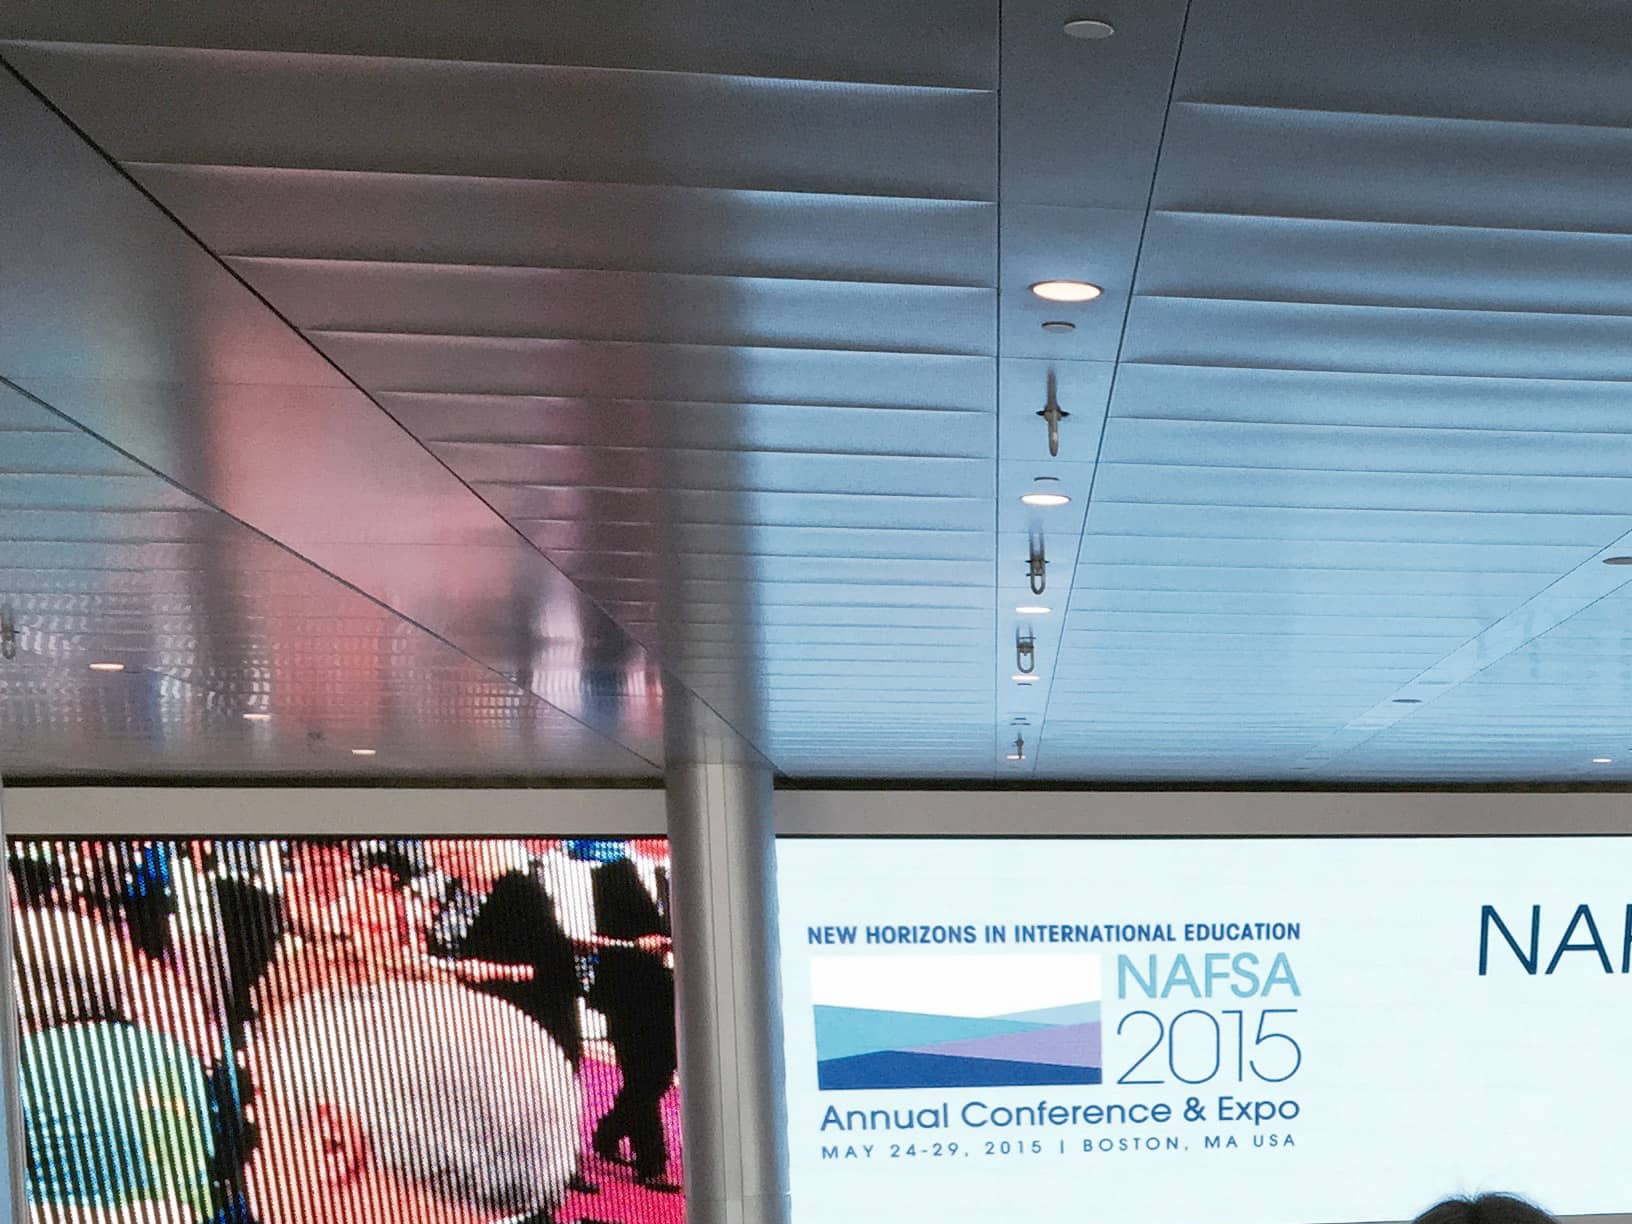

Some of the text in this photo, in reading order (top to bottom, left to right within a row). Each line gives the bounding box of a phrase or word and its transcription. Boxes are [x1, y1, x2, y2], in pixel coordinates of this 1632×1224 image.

[807, 922, 1301, 944] NEW HORIZONS IN INTERNATIONAL EDUCATION
[1117, 951, 1302, 999] NAFSA
[1116, 1009, 1302, 1085] 2015
[820, 1096, 1301, 1132] Annual Conference & Expo
[821, 1144, 875, 1160] MAY
[890, 1142, 970, 1159] 24-29,
[985, 1140, 1042, 1156] 2015
[1083, 1136, 1188, 1154] BOSTON,
[1204, 1135, 1238, 1149] MA
[1253, 1134, 1295, 1148] USA
